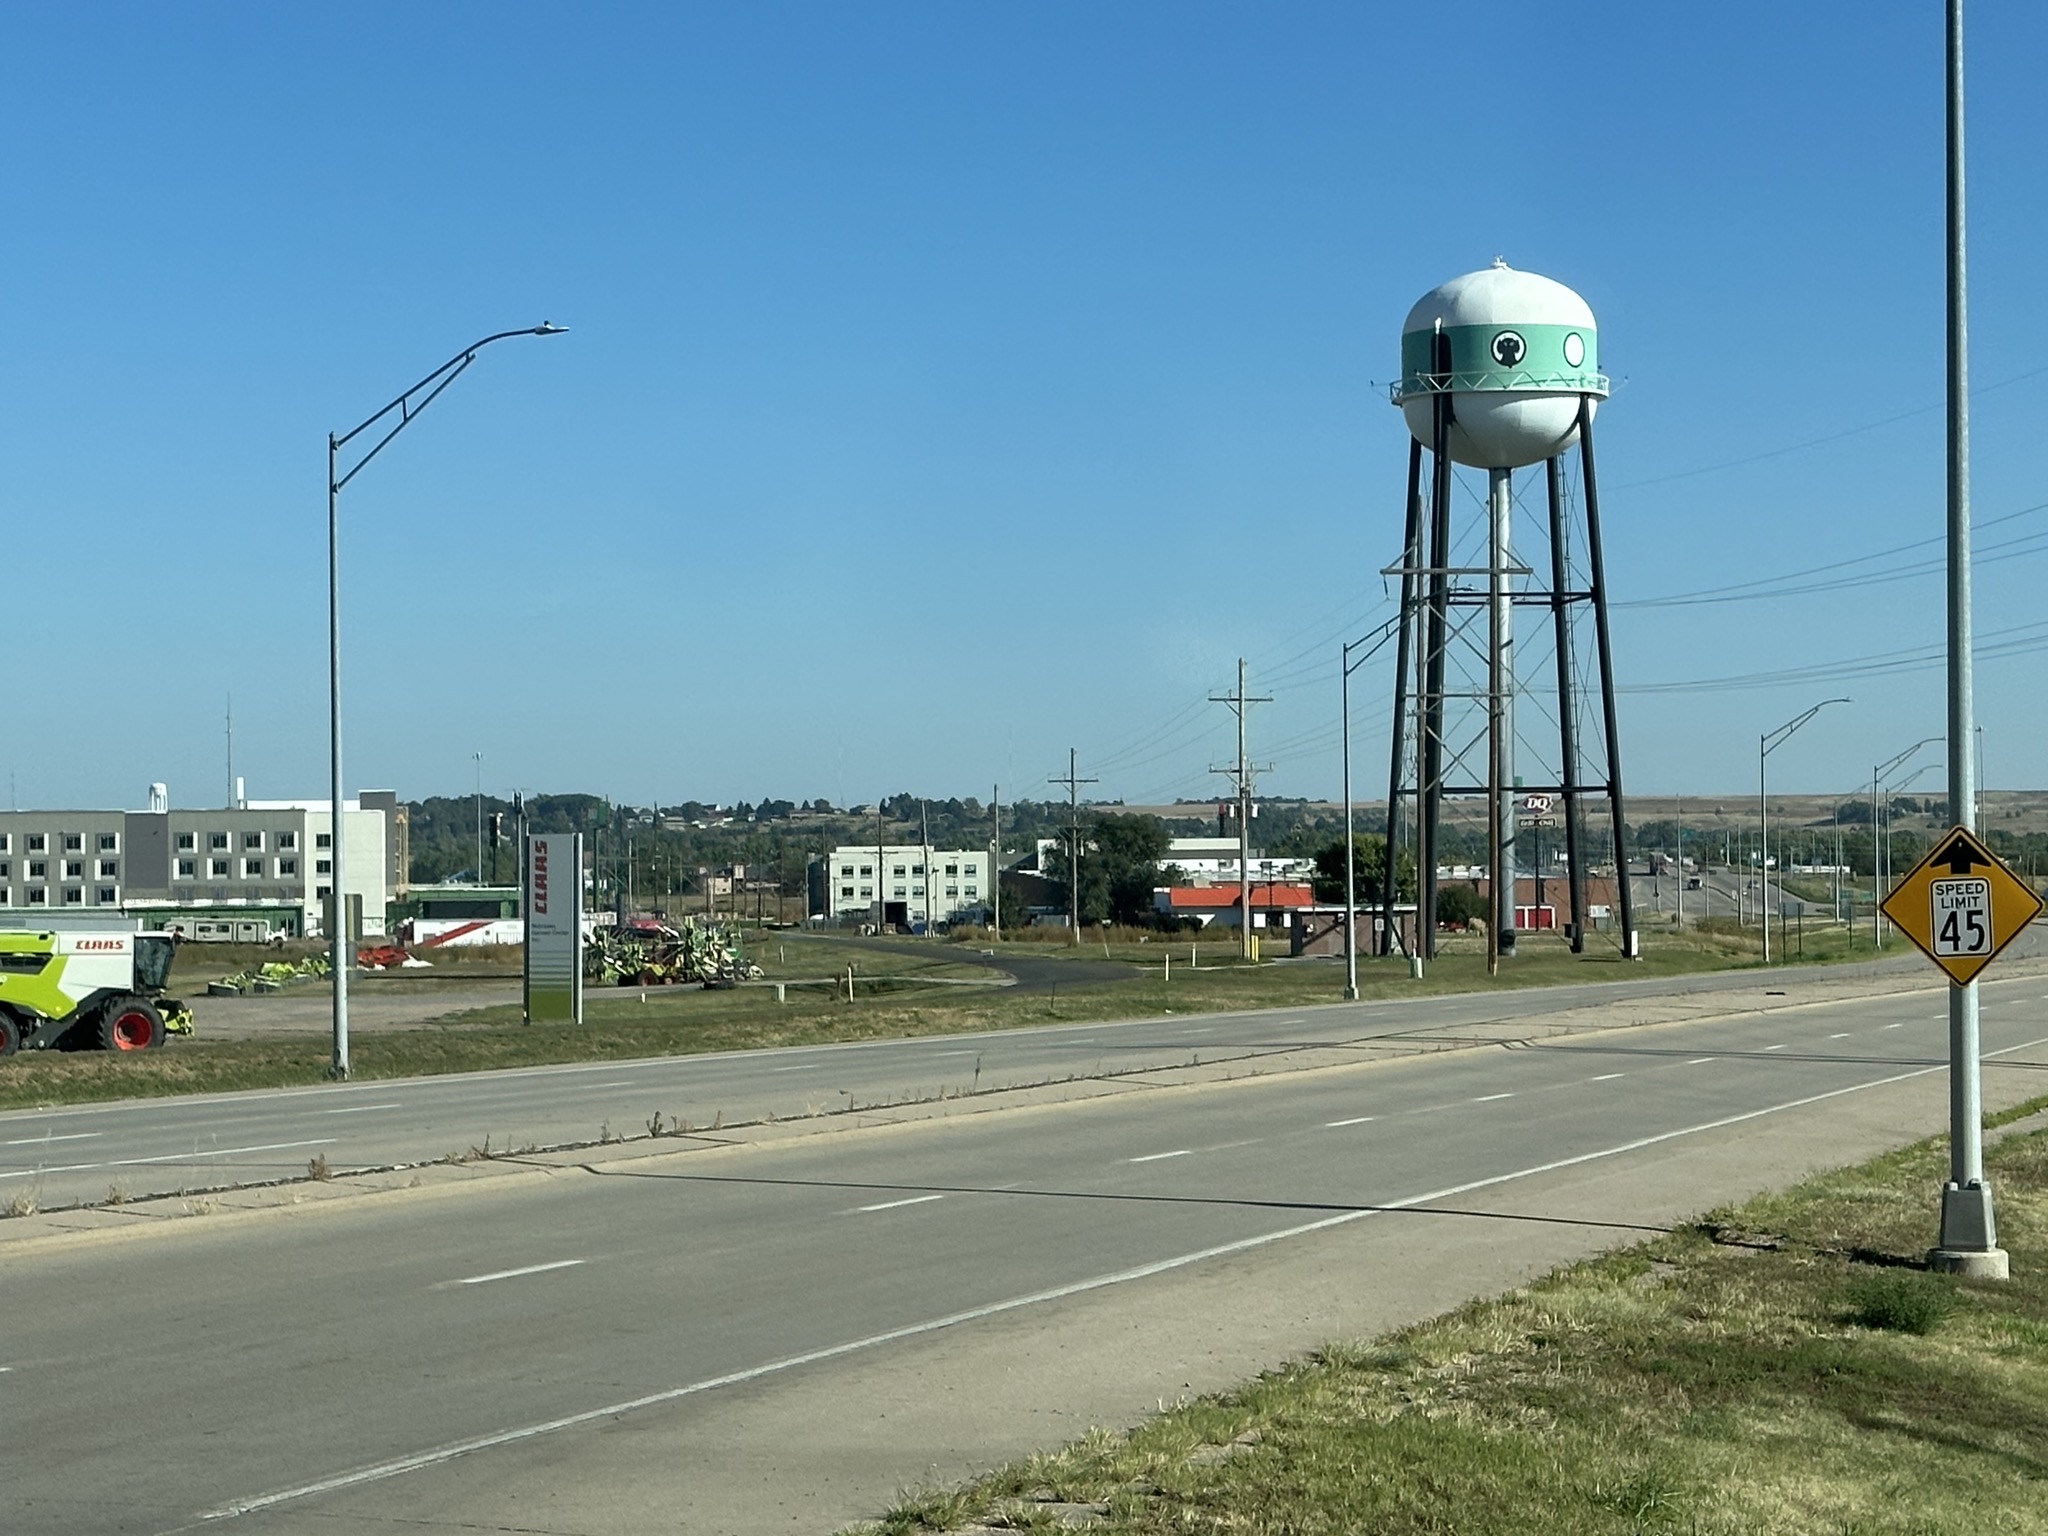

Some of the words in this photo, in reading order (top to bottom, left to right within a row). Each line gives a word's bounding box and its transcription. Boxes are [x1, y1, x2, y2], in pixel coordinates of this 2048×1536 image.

[1527, 797, 1548, 810] DQ
[535, 840, 547, 915] CLAAS
[1935, 883, 1985, 896] SPEED
[1941, 896, 1980, 909] LIMIT
[1940, 909, 1985, 951] 45
[75, 940, 125, 950] CLAAS
